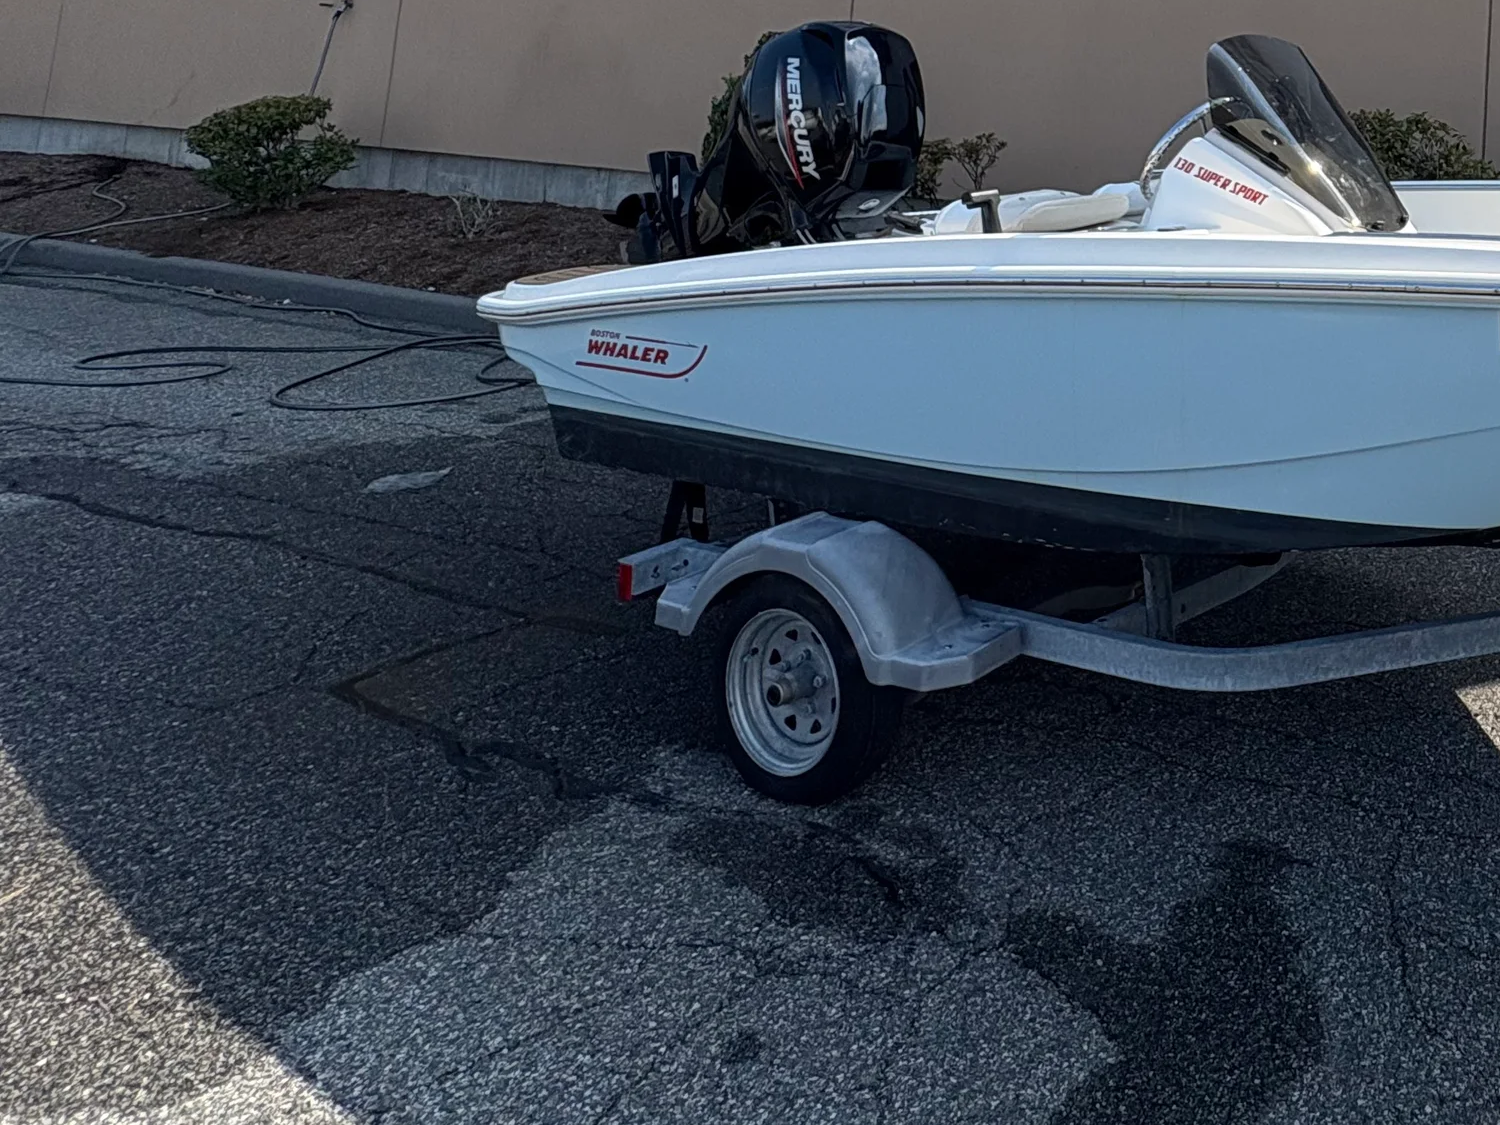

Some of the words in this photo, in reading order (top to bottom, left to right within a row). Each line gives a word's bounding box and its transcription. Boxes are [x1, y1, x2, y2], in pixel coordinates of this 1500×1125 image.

[786, 57, 821, 180] MERCURY
[1173, 156, 1196, 174] 130
[1193, 166, 1232, 190] SUPER
[1229, 181, 1269, 205] SPORT
[587, 339, 669, 365] WHALER
[590, 328, 621, 340] BOSTON
